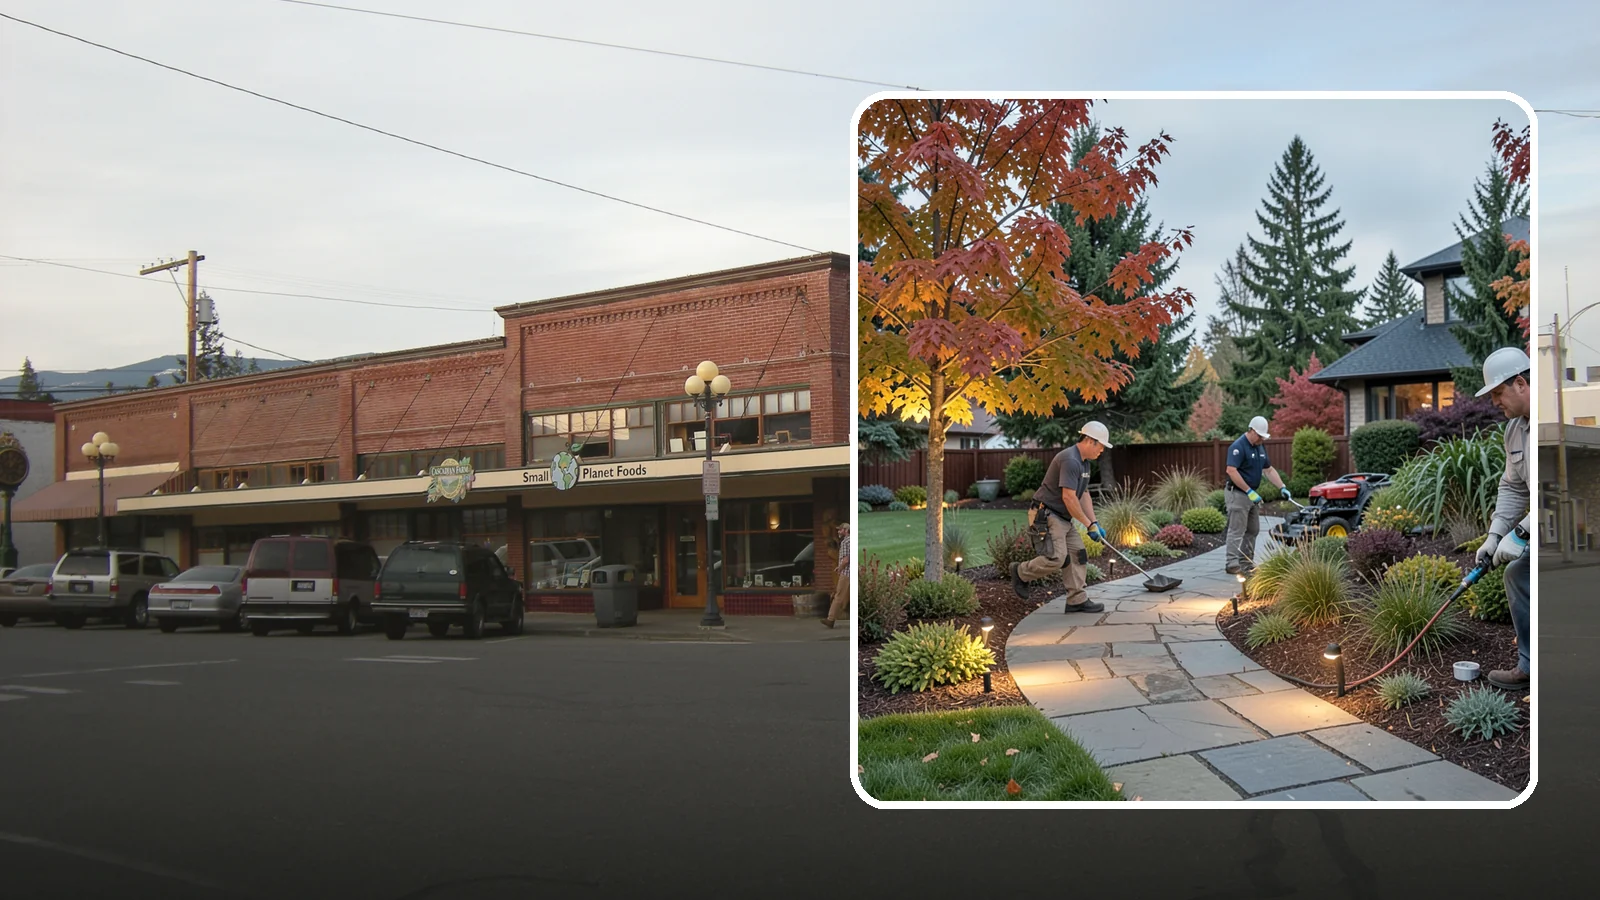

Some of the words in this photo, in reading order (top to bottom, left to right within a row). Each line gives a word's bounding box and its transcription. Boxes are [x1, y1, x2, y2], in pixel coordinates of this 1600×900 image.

[523, 471, 549, 483] Small
[582, 467, 614, 479] Planet
[616, 464, 647, 477] Foods
